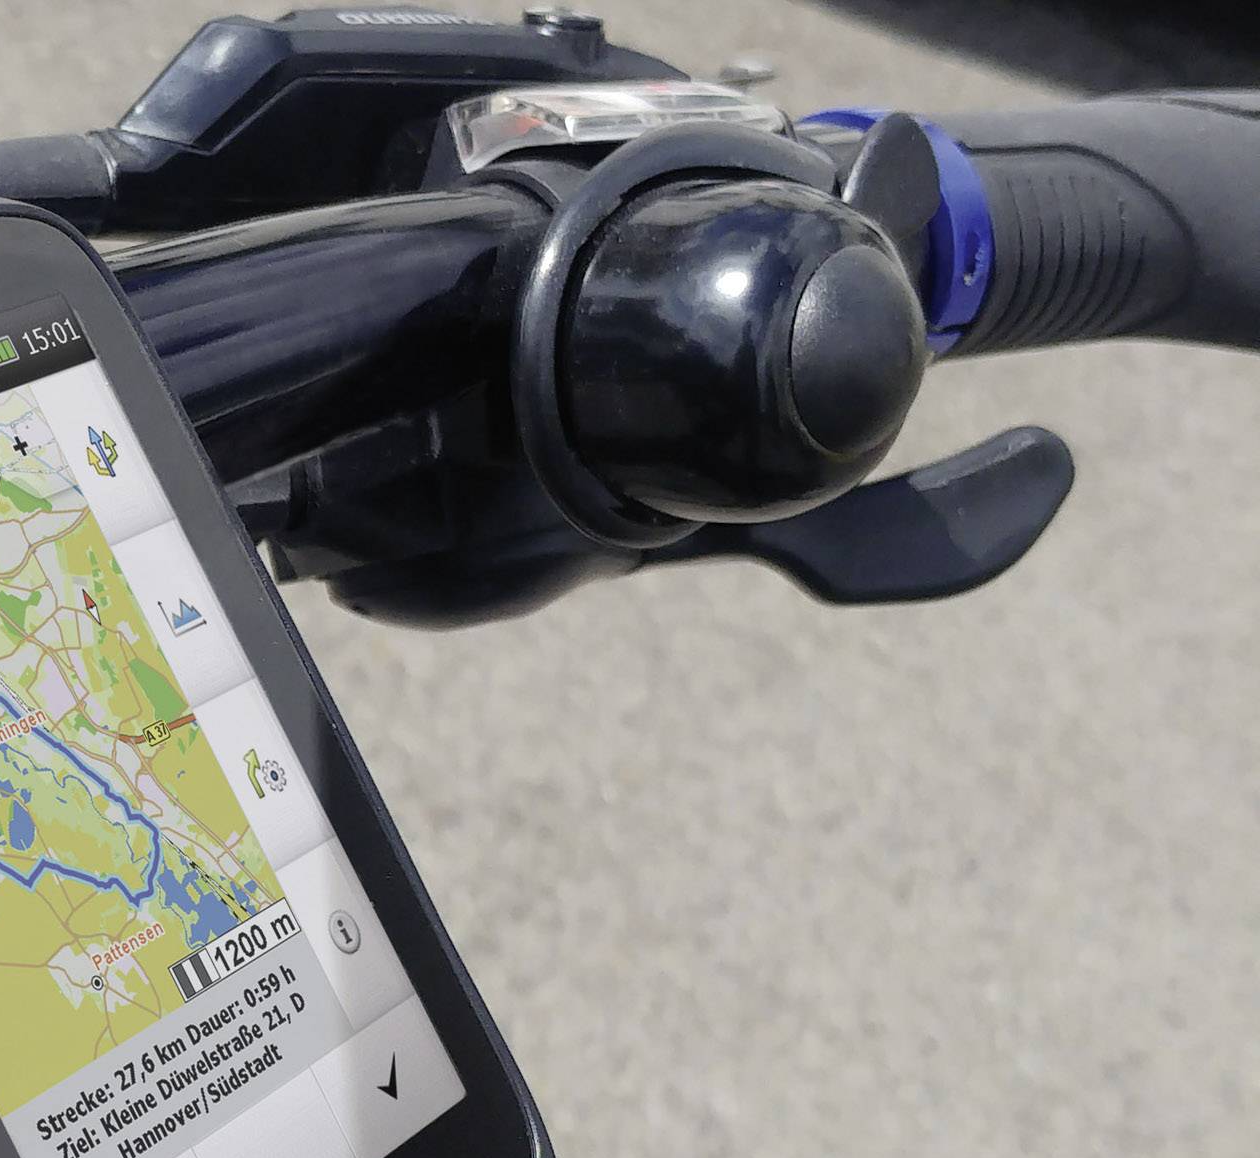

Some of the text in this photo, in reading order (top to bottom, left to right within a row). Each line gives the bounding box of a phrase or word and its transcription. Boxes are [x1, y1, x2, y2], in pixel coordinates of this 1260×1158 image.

[22, 317, 81, 356] 15:01
[145, 721, 168, 745] A 37
[91, 921, 164, 970] Pattensen
[213, 914, 296, 973] 1200 m
[36, 964, 297, 1141] Strecke: 27,6 km Dauer: 0:59 h
[100, 1087, 158, 1143] Kleine
[159, 1023, 264, 1099] Düwelstraße
[262, 1006, 292, 1034] 21,
[291, 992, 306, 1013] D
